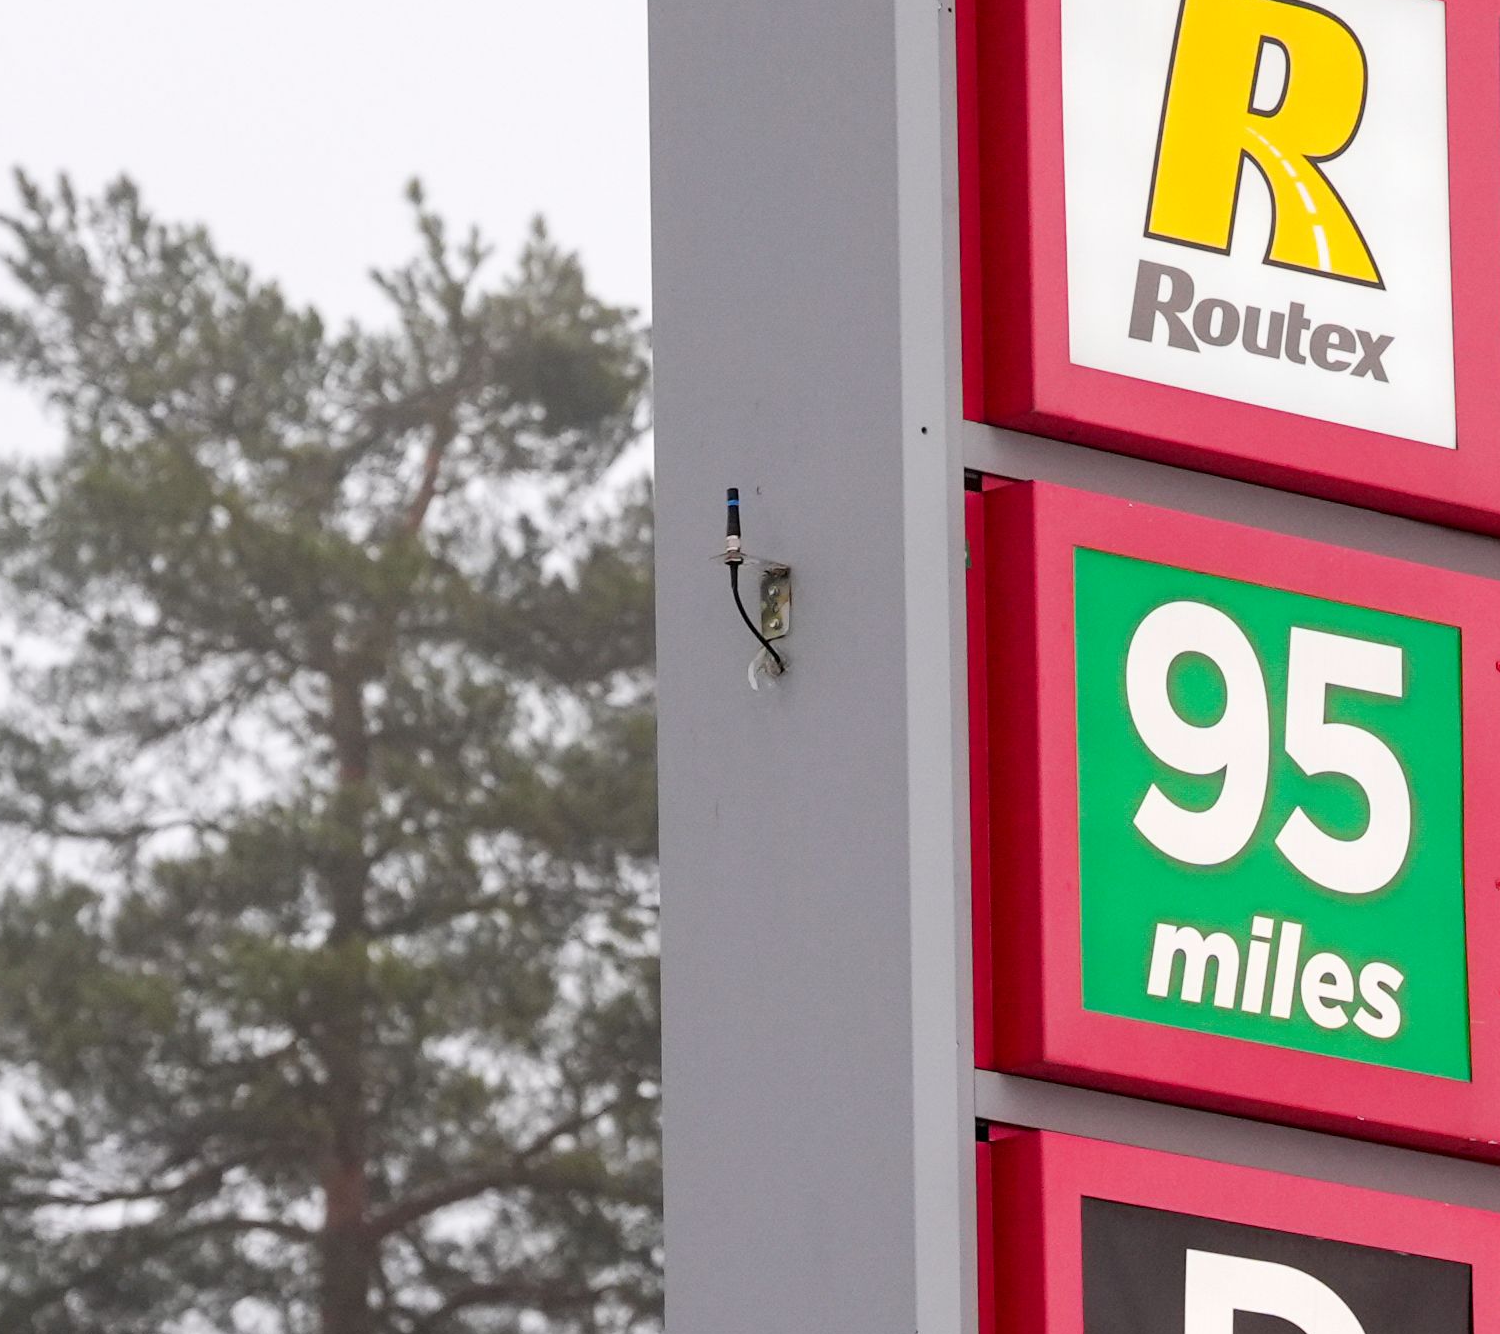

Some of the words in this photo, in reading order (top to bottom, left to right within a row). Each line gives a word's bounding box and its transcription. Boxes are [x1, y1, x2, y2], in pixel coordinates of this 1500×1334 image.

[1127, 259, 1394, 383] Routex
[1126, 601, 1411, 894] 95
[1146, 915, 1404, 1039] miles
